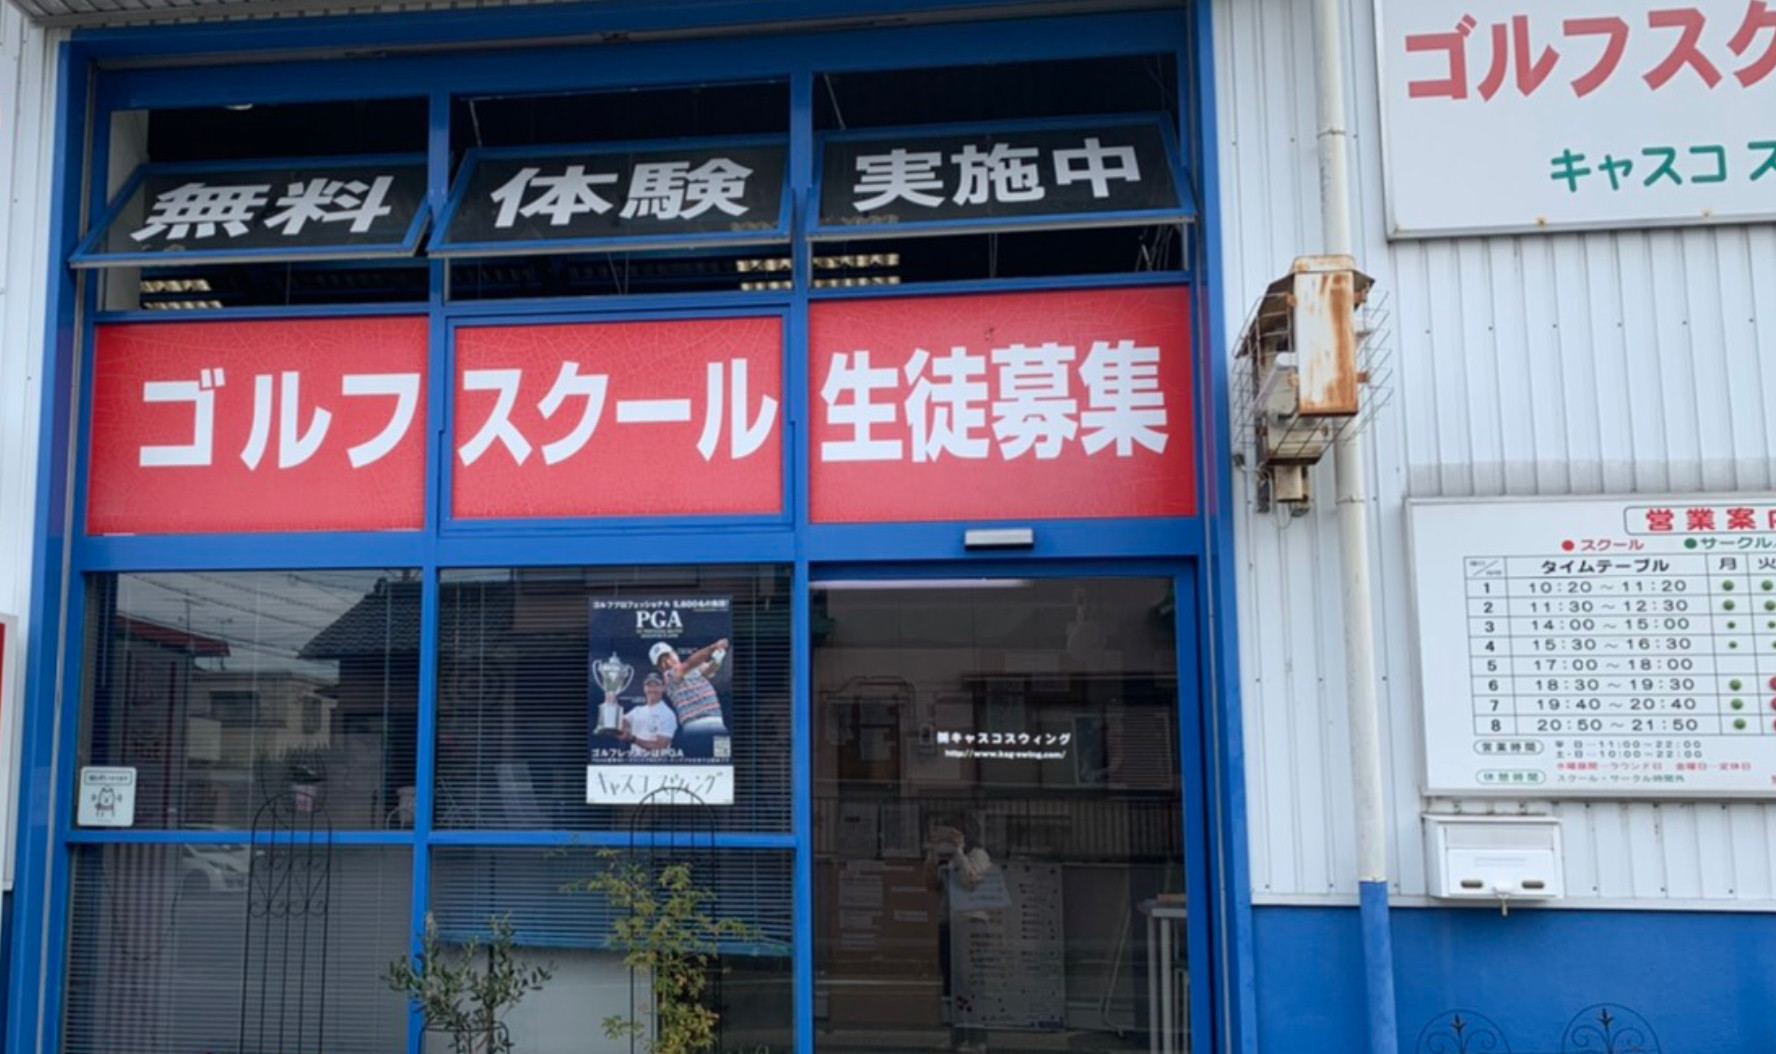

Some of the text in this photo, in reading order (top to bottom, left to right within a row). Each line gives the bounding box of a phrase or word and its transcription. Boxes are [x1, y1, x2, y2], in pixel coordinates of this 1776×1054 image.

[131, 137, 1142, 242] 無料 体験 実施中
[1580, 536, 1776, 552] スクール サークル
[1541, 558, 1670, 575] タイムテーブル
[1719, 557, 1737, 571] 月
[1483, 582, 1491, 594] 1
[1483, 601, 1494, 614] 2
[635, 610, 684, 629] PGA
[1484, 621, 1495, 633] 3
[1484, 640, 1496, 652] 4
[1487, 660, 1498, 672] 5
[1488, 679, 1499, 692] 6
[1489, 699, 1500, 712] 7
[1490, 718, 1502, 732] 8
